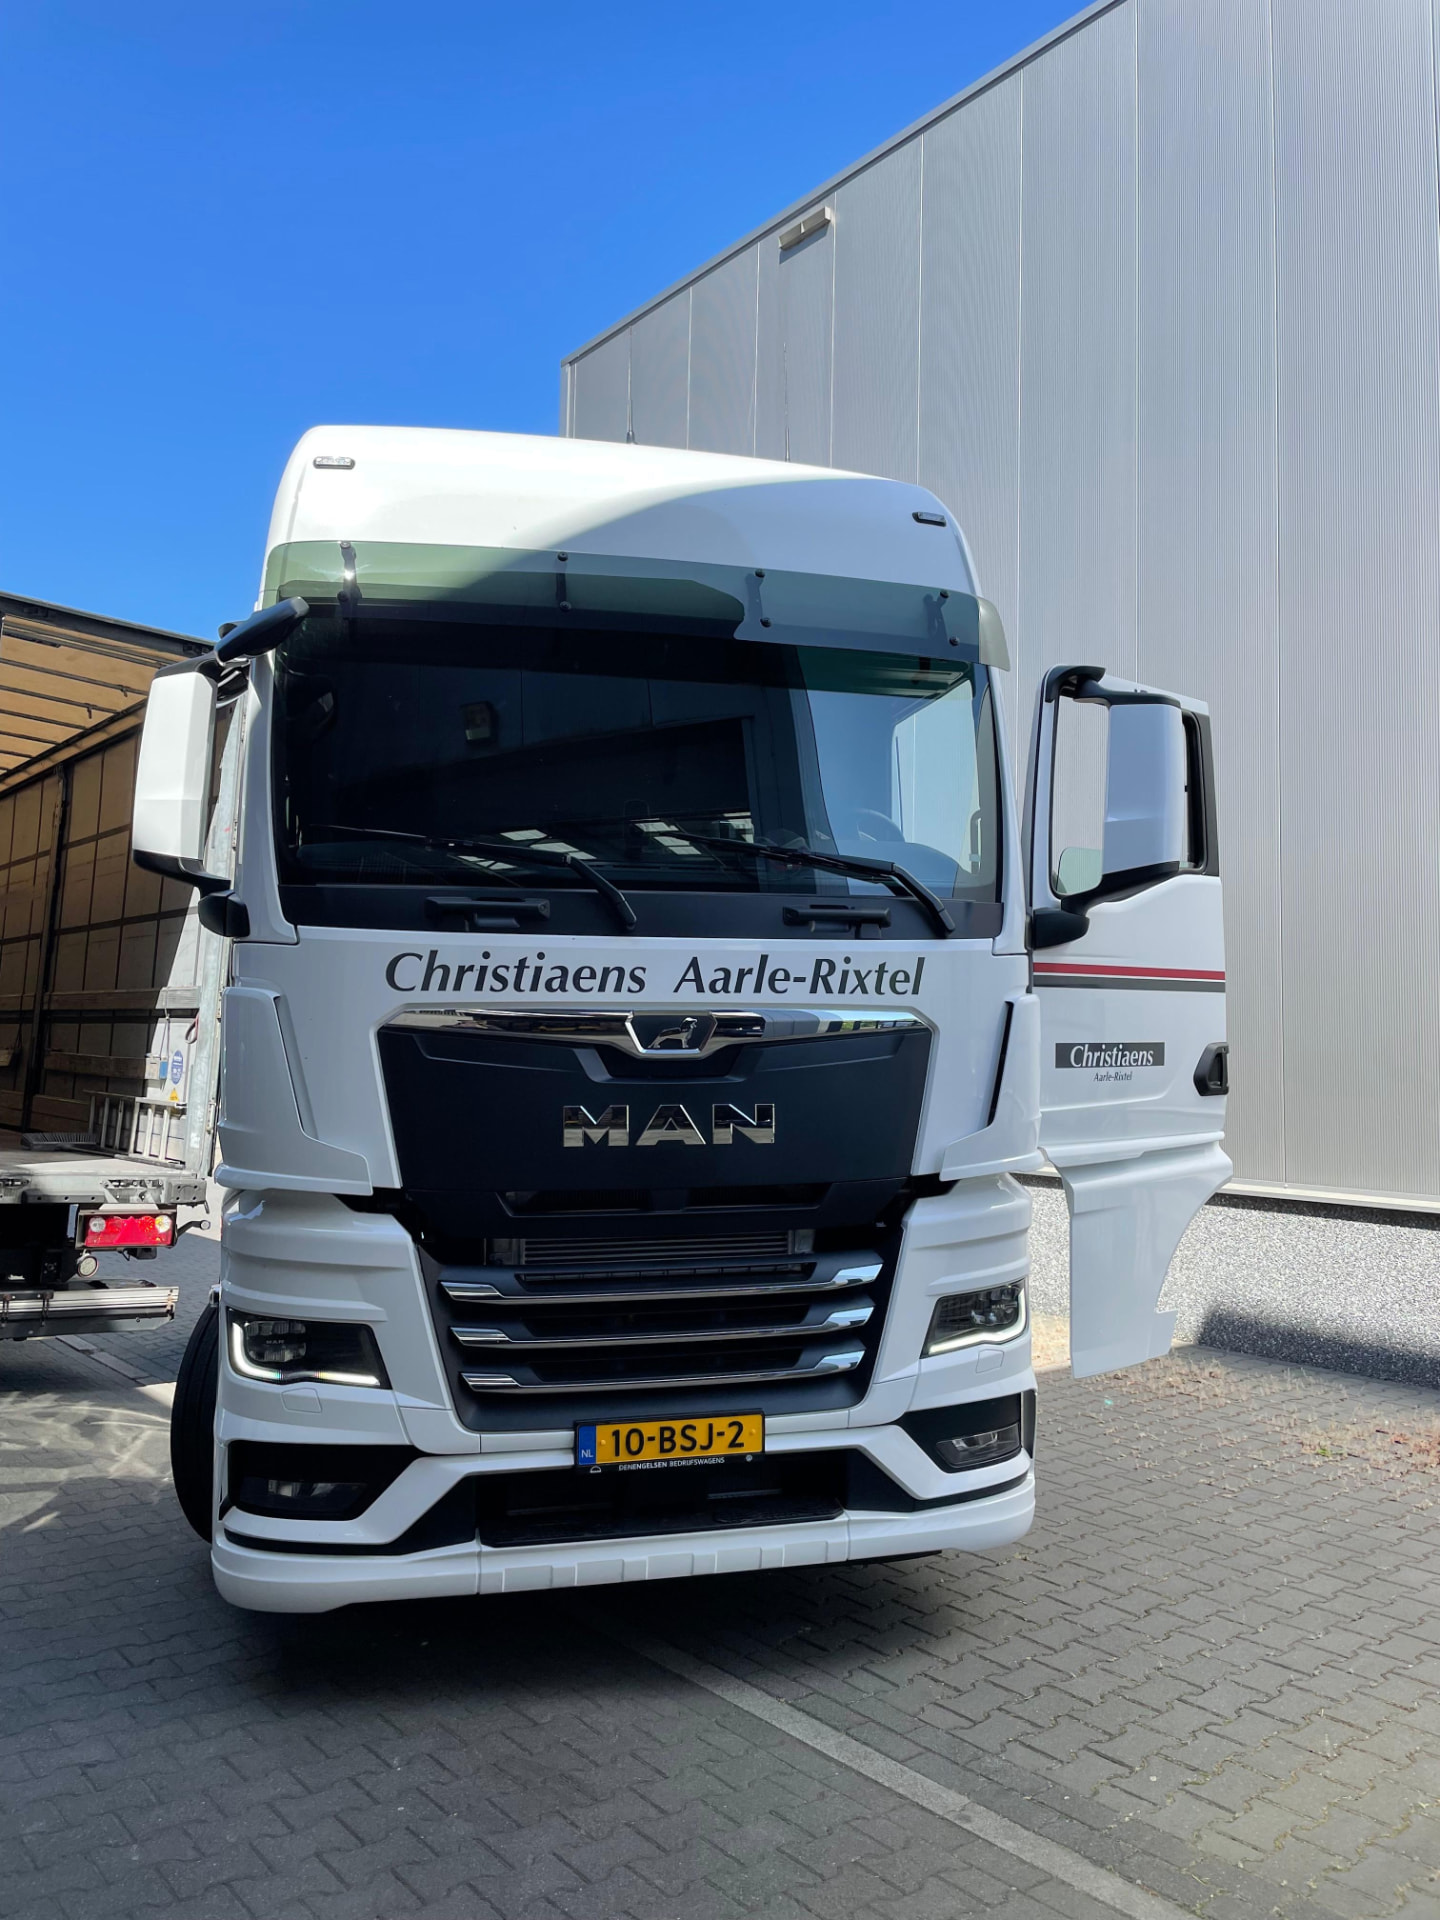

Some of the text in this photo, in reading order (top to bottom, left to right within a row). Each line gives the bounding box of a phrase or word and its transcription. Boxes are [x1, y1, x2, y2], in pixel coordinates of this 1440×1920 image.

[385, 949, 926, 996] Christiaens Aarle-Rixtel
[1069, 1043, 1154, 1068] Christiaens
[1093, 1071, 1133, 1083] Aarle-Rixtel
[562, 1103, 776, 1148] MAN
[611, 1420, 745, 1457] 10-BSJ-2
[581, 1449, 594, 1459] NL
[669, 1456, 725, 1468] BEDRIJFSWAGENS
